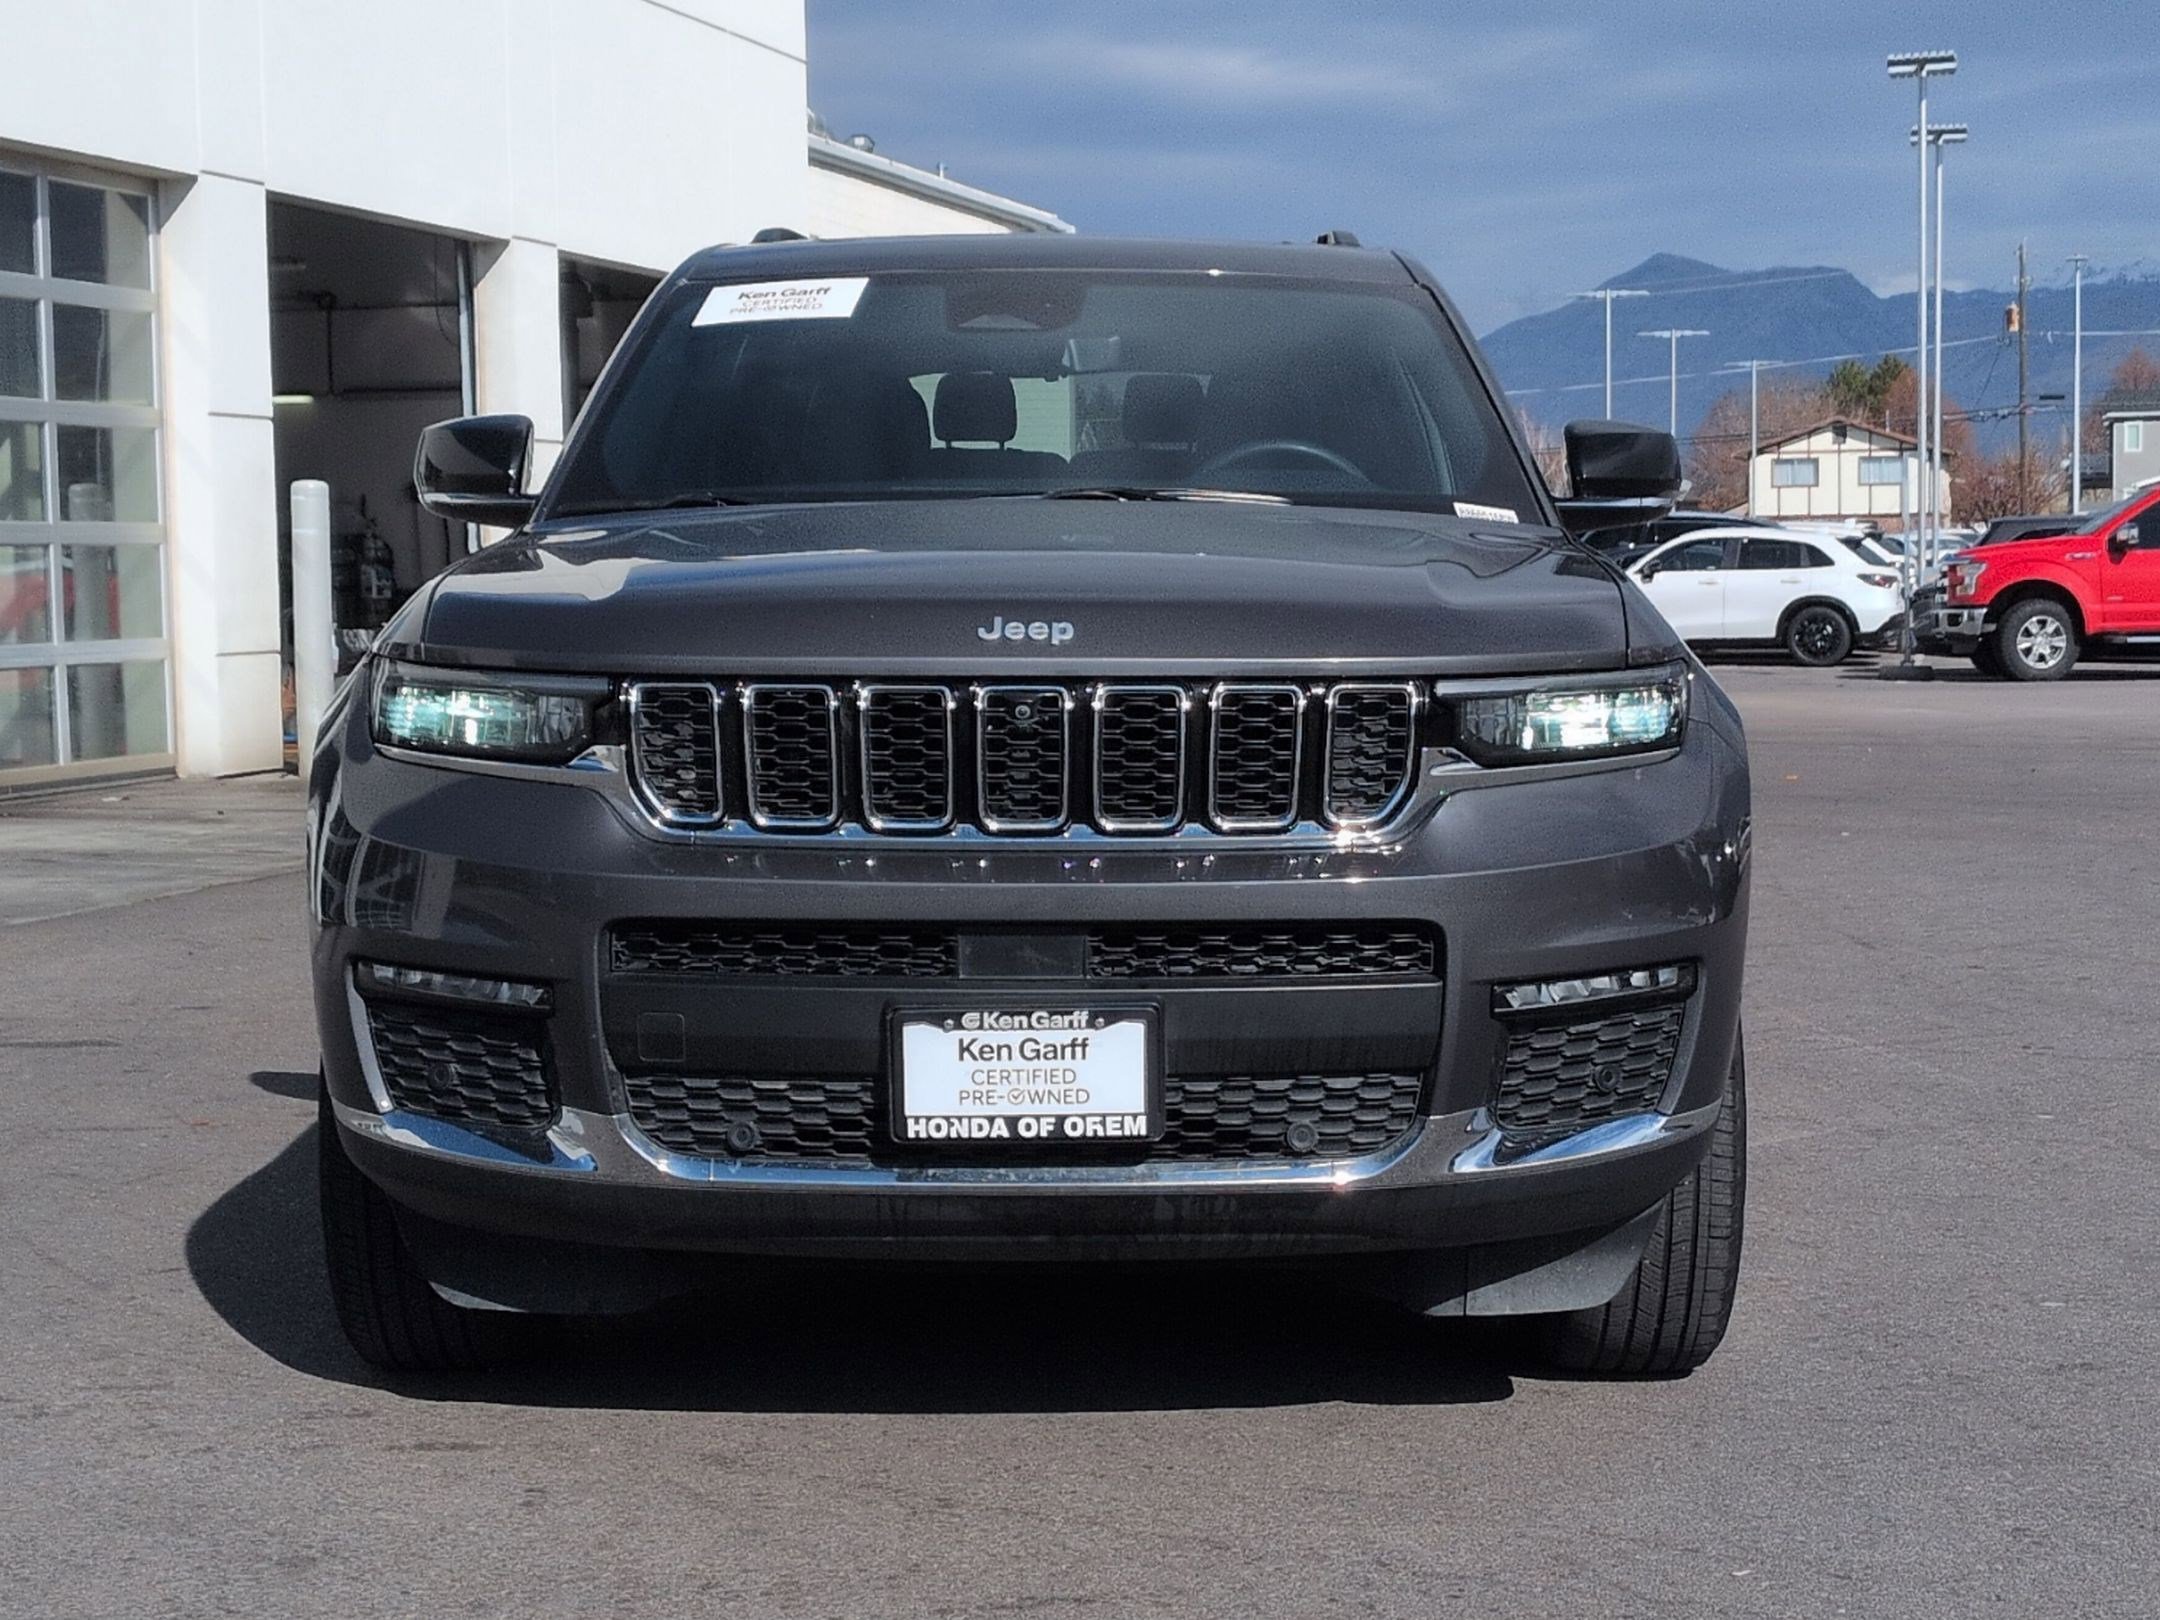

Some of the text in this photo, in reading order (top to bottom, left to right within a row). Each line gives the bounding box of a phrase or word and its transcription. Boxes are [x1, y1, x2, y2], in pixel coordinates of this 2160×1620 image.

[977, 615, 1075, 646] Jeep
[982, 1011, 1089, 1029] Ken Garff
[958, 1037, 1089, 1062] Ken Garff
[971, 1068, 1077, 1085] CERTIFIED
[906, 1115, 1147, 1139] HONDA OF OREM
